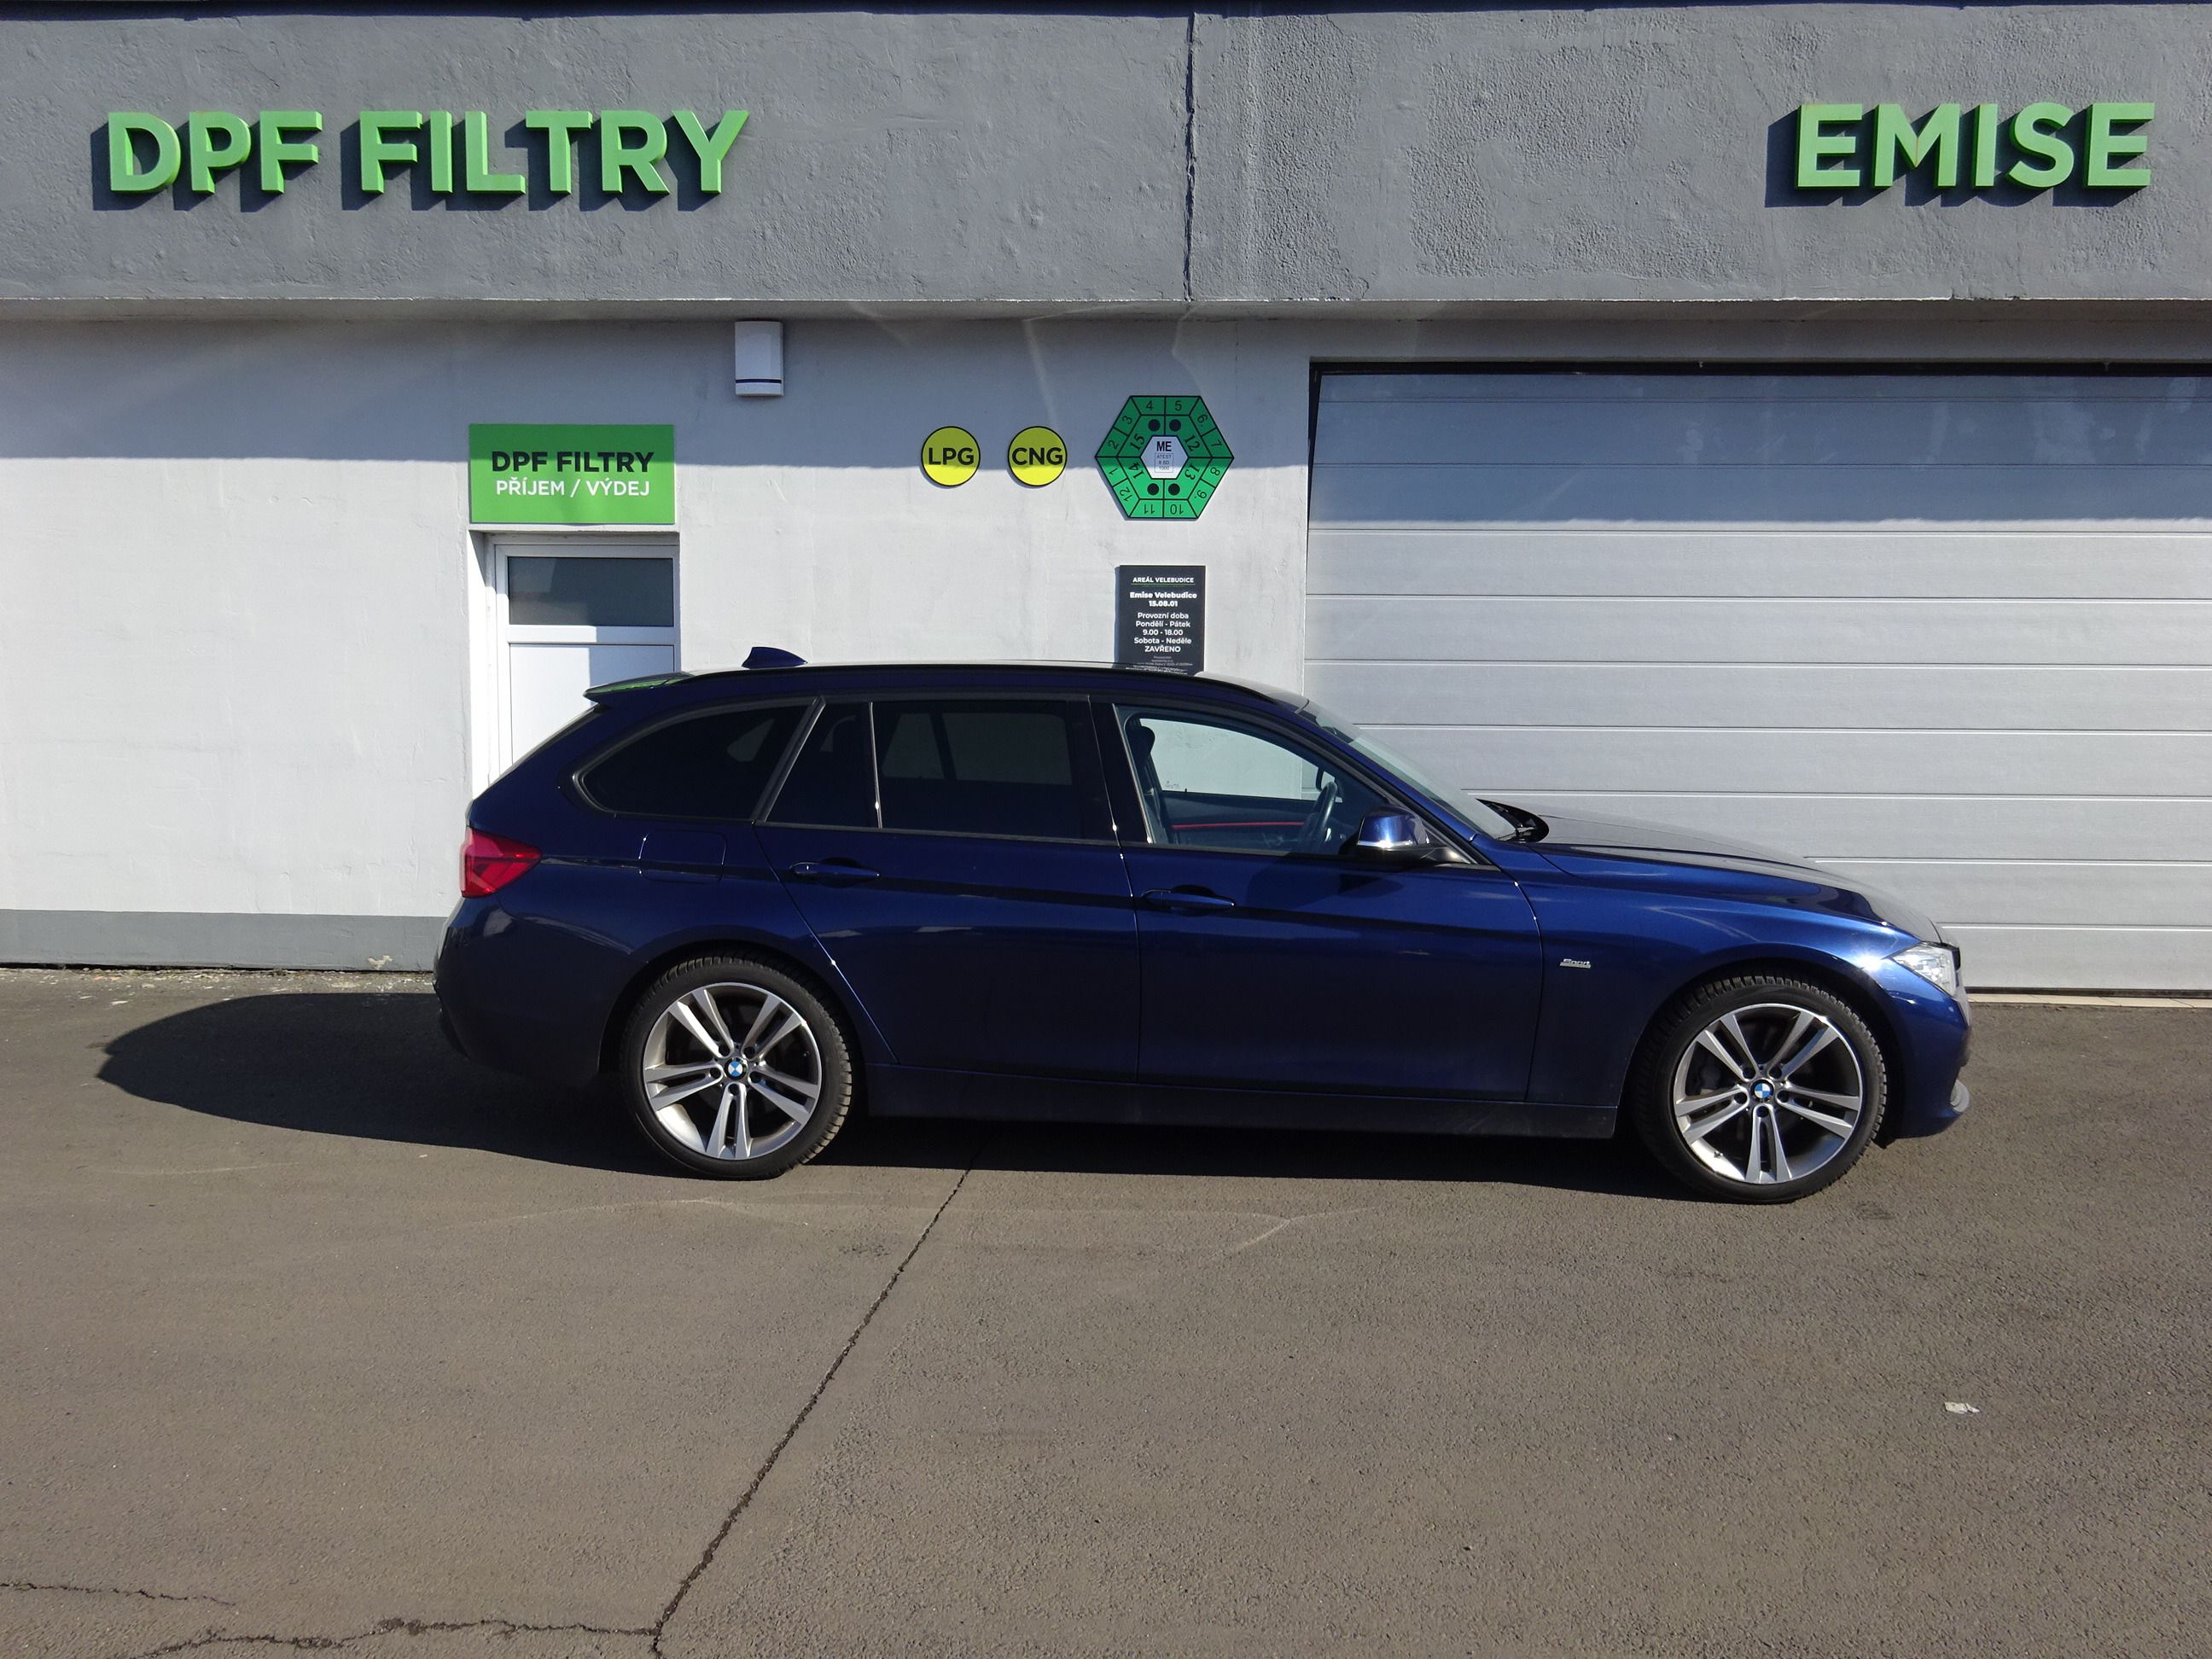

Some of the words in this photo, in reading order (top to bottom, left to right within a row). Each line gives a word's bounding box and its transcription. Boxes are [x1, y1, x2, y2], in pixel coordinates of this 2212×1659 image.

[108, 110, 323, 195] DPF
[358, 109, 750, 195] FILTRY
[1795, 102, 2156, 189] EMISE
[1146, 400, 1153, 410] 4
[1174, 400, 1182, 410] 5
[1122, 416, 1132, 424] 3
[1109, 439, 1120, 450] 2
[1130, 434, 1145, 451] 15
[1156, 440, 1172, 452] ME
[1184, 434, 1201, 452] 12
[492, 451, 548, 472] DPF
[556, 451, 655, 473] FILTRY
[928, 447, 975, 465] LPG
[1011, 446, 1063, 465] CNG
[1128, 462, 1144, 479] 14
[1185, 463, 1200, 480] 13
[1210, 466, 1220, 476] 8
[496, 476, 565, 496] PŘÍJEM
[570, 478, 581, 498] /
[586, 477, 650, 497] VÝDEJ
[1119, 486, 1133, 502] 12
[1144, 504, 1155, 515] 11
[1170, 504, 1185, 515] 10
[1154, 591, 1198, 599] Velebudice
